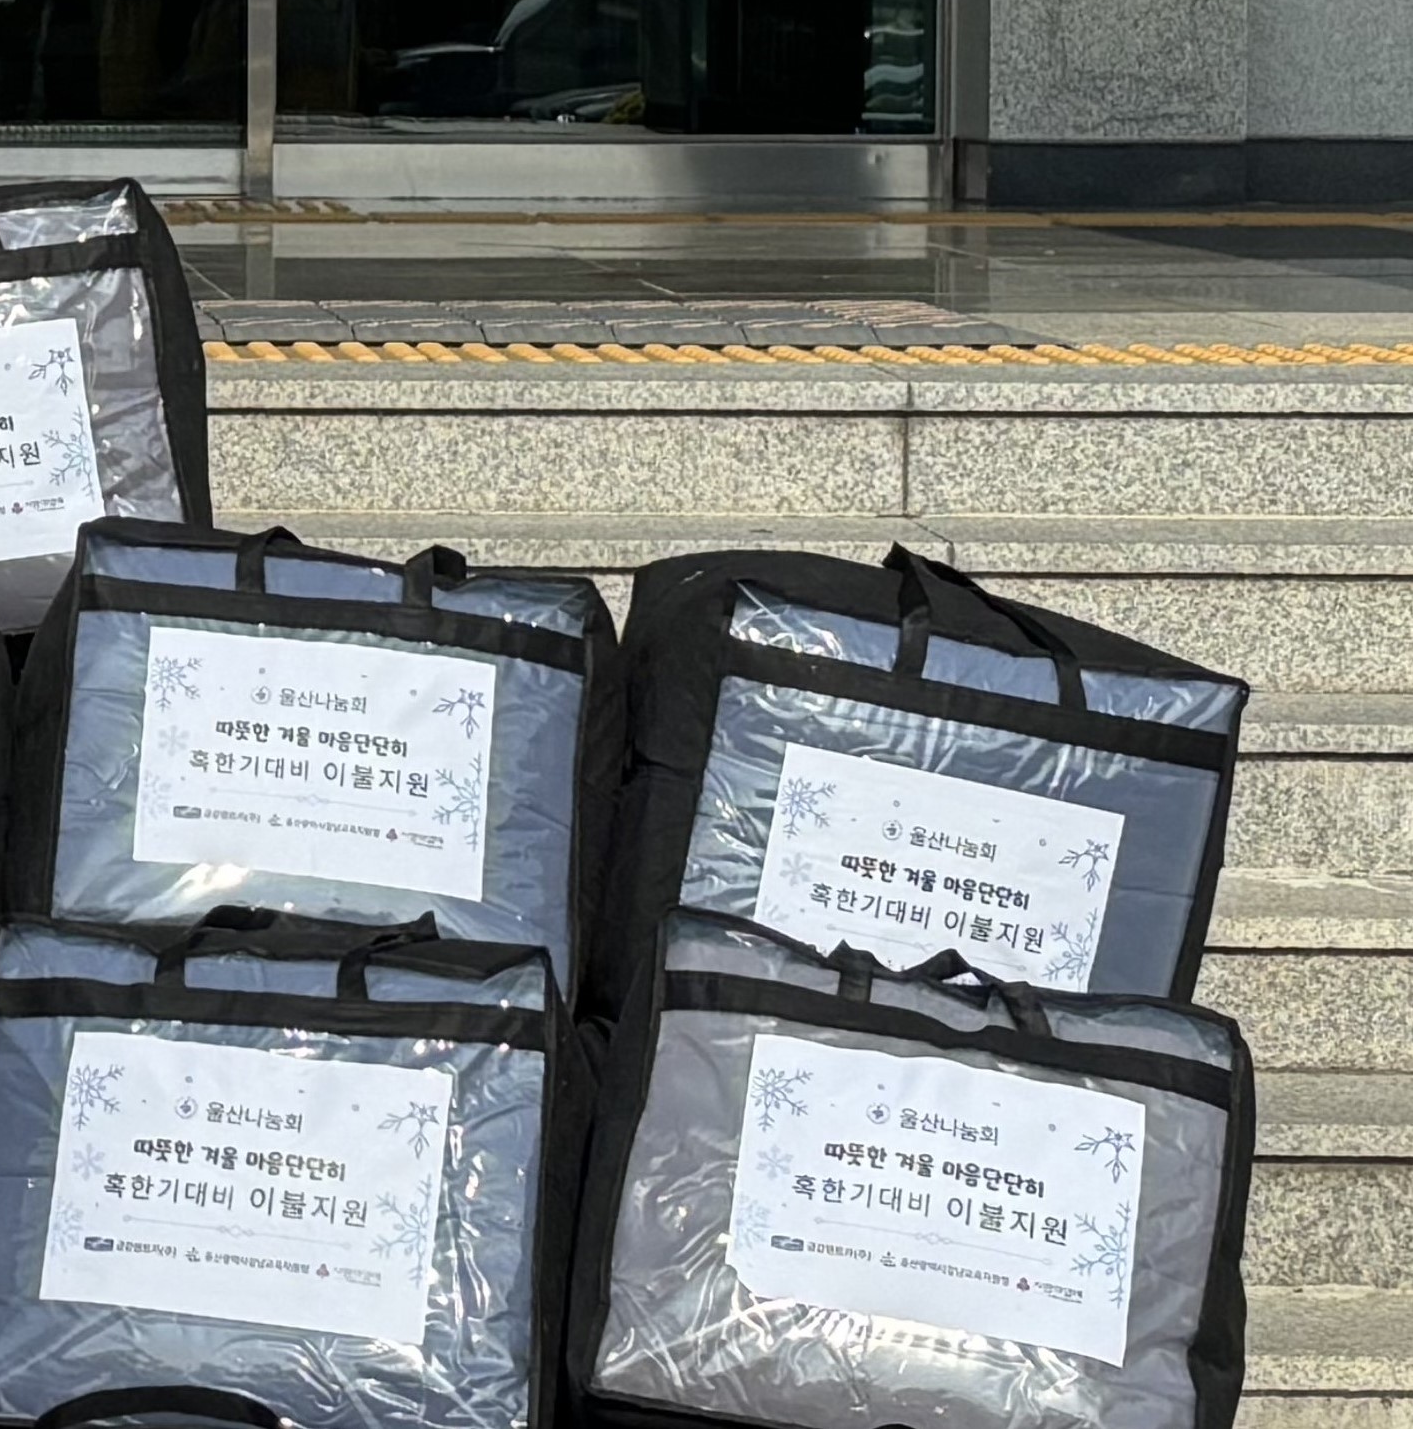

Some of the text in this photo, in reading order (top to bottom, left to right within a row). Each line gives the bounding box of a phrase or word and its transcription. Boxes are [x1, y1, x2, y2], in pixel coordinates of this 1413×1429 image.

[280, 689, 367, 713] 울산나눔회
[216, 721, 407, 757] 따뜻한 겨울 마음단단히
[189, 749, 428, 798] 혹한기대비 이불지원
[909, 826, 996, 862] 울산나눔회
[841, 855, 1029, 910] 따뜻한 겨울 마음단단히
[810, 882, 1044, 954] 혹한기대비 이불지원
[206, 1102, 303, 1132] 울산나눔회
[899, 1108, 999, 1145] 울산나눔회
[134, 1139, 345, 1181] 따뜻한 겨울 마음단단히
[825, 1142, 1044, 1197] 따뜻한 겨울 마음단단히
[104, 1173, 368, 1227] 혹한기대비 이불지원
[792, 1174, 1069, 1246] 혹한기대비 이불지원
